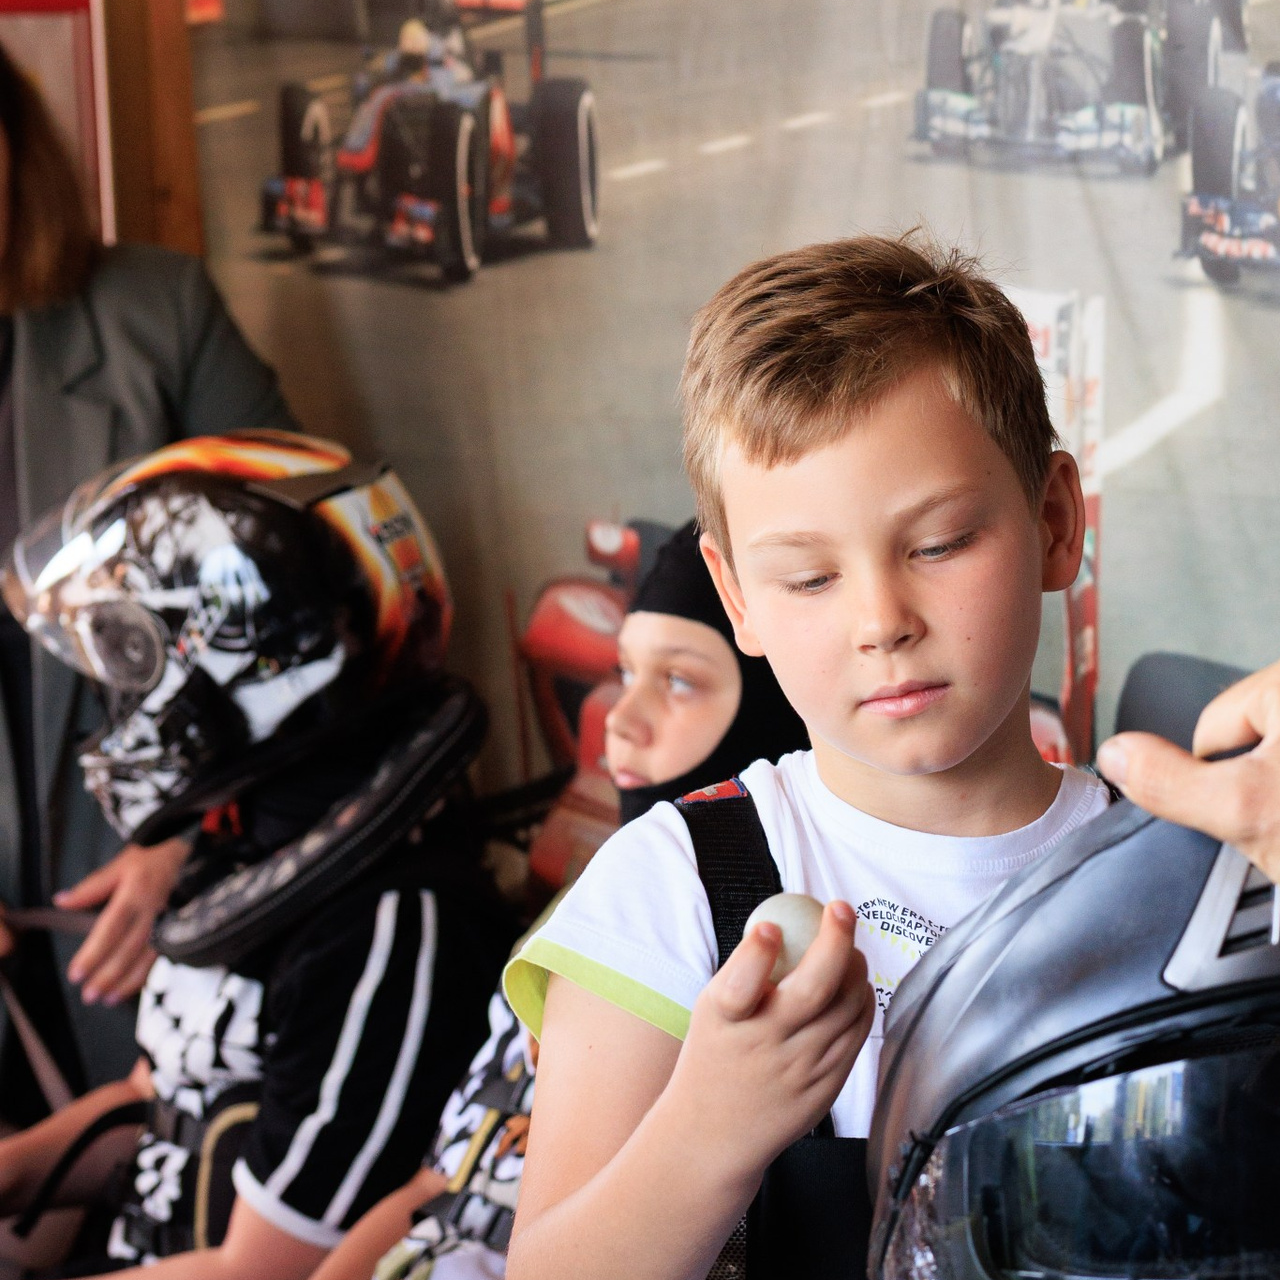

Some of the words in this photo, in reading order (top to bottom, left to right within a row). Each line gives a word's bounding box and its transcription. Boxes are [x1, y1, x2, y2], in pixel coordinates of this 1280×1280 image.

[877, 897, 900, 913] NEW
[901, 907, 926, 923] ERA
[880, 921, 938, 946] DISCOVE
